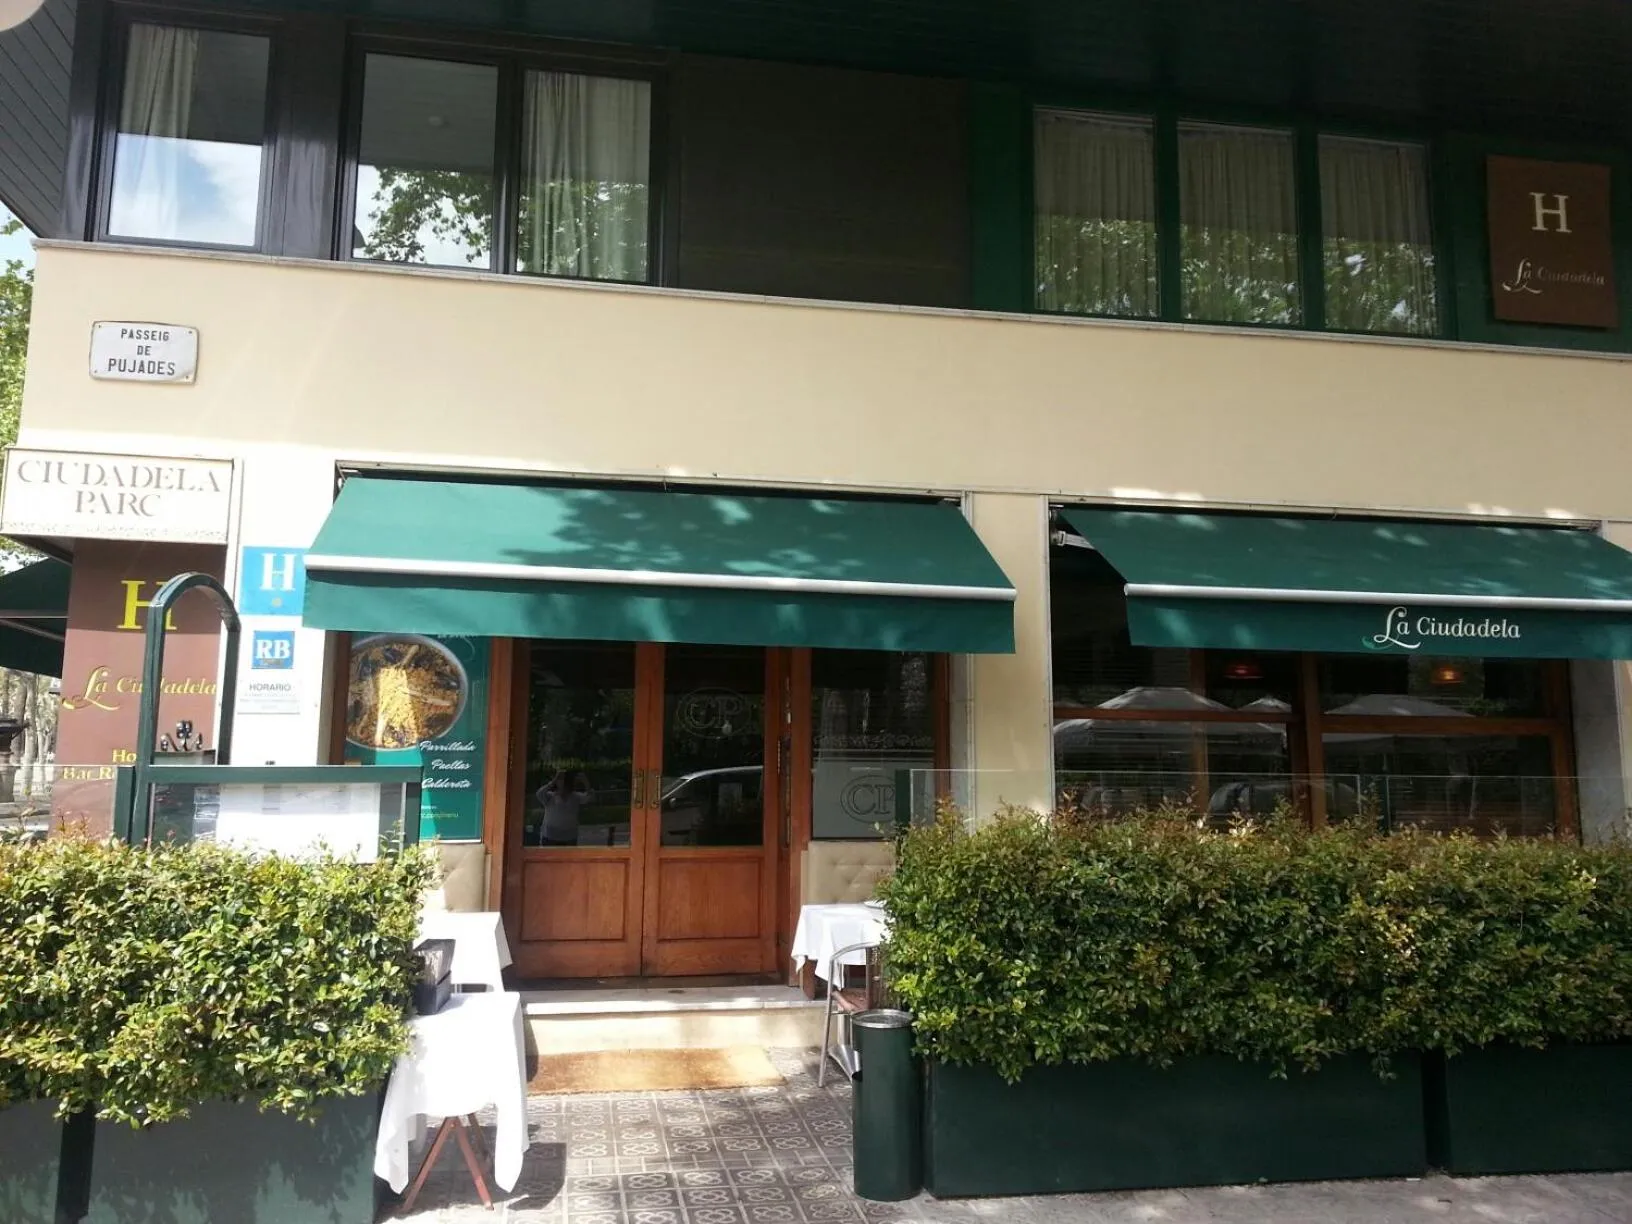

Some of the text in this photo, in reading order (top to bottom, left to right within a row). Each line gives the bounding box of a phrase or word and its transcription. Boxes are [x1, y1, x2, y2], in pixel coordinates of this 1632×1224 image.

[1529, 192, 1572, 233] H
[121, 328, 170, 341] PASSEIG
[137, 345, 152, 356] DE
[108, 358, 175, 376] PUJADES
[17, 459, 221, 493] CIUDADELA
[74, 490, 161, 517] PARC
[259, 552, 297, 592] H
[117, 580, 177, 630] H
[1373, 605, 1521, 649] La Ciudadela
[255, 639, 291, 659] RB
[63, 666, 120, 710] La
[249, 682, 292, 692] HORARIO
[431, 758, 472, 770] Paellas
